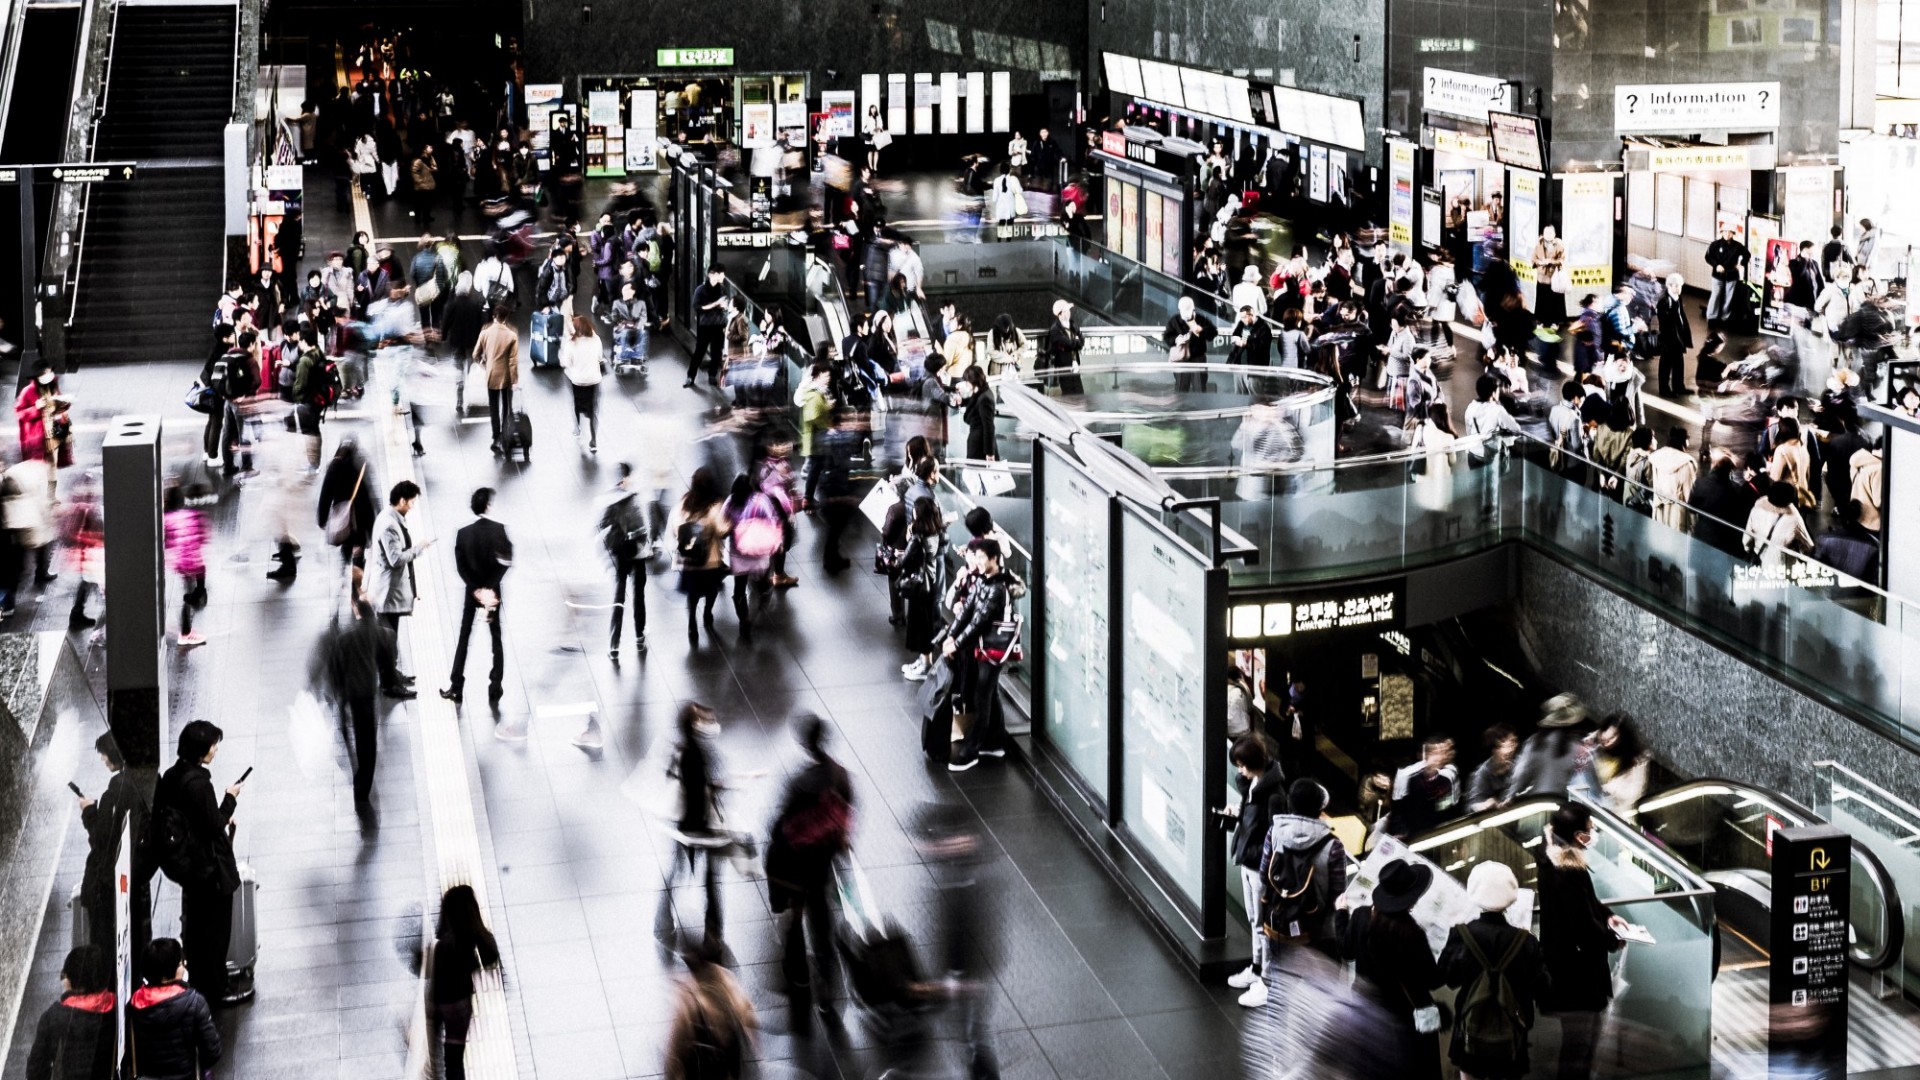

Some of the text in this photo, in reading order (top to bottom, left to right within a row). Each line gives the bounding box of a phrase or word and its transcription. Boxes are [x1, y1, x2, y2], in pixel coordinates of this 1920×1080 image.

[1441, 78, 1492, 97] Information
[1626, 90, 1770, 113] ? Information ?
[1295, 618, 1332, 632] LAVATORY
[1811, 877, 1831, 891] B1F
